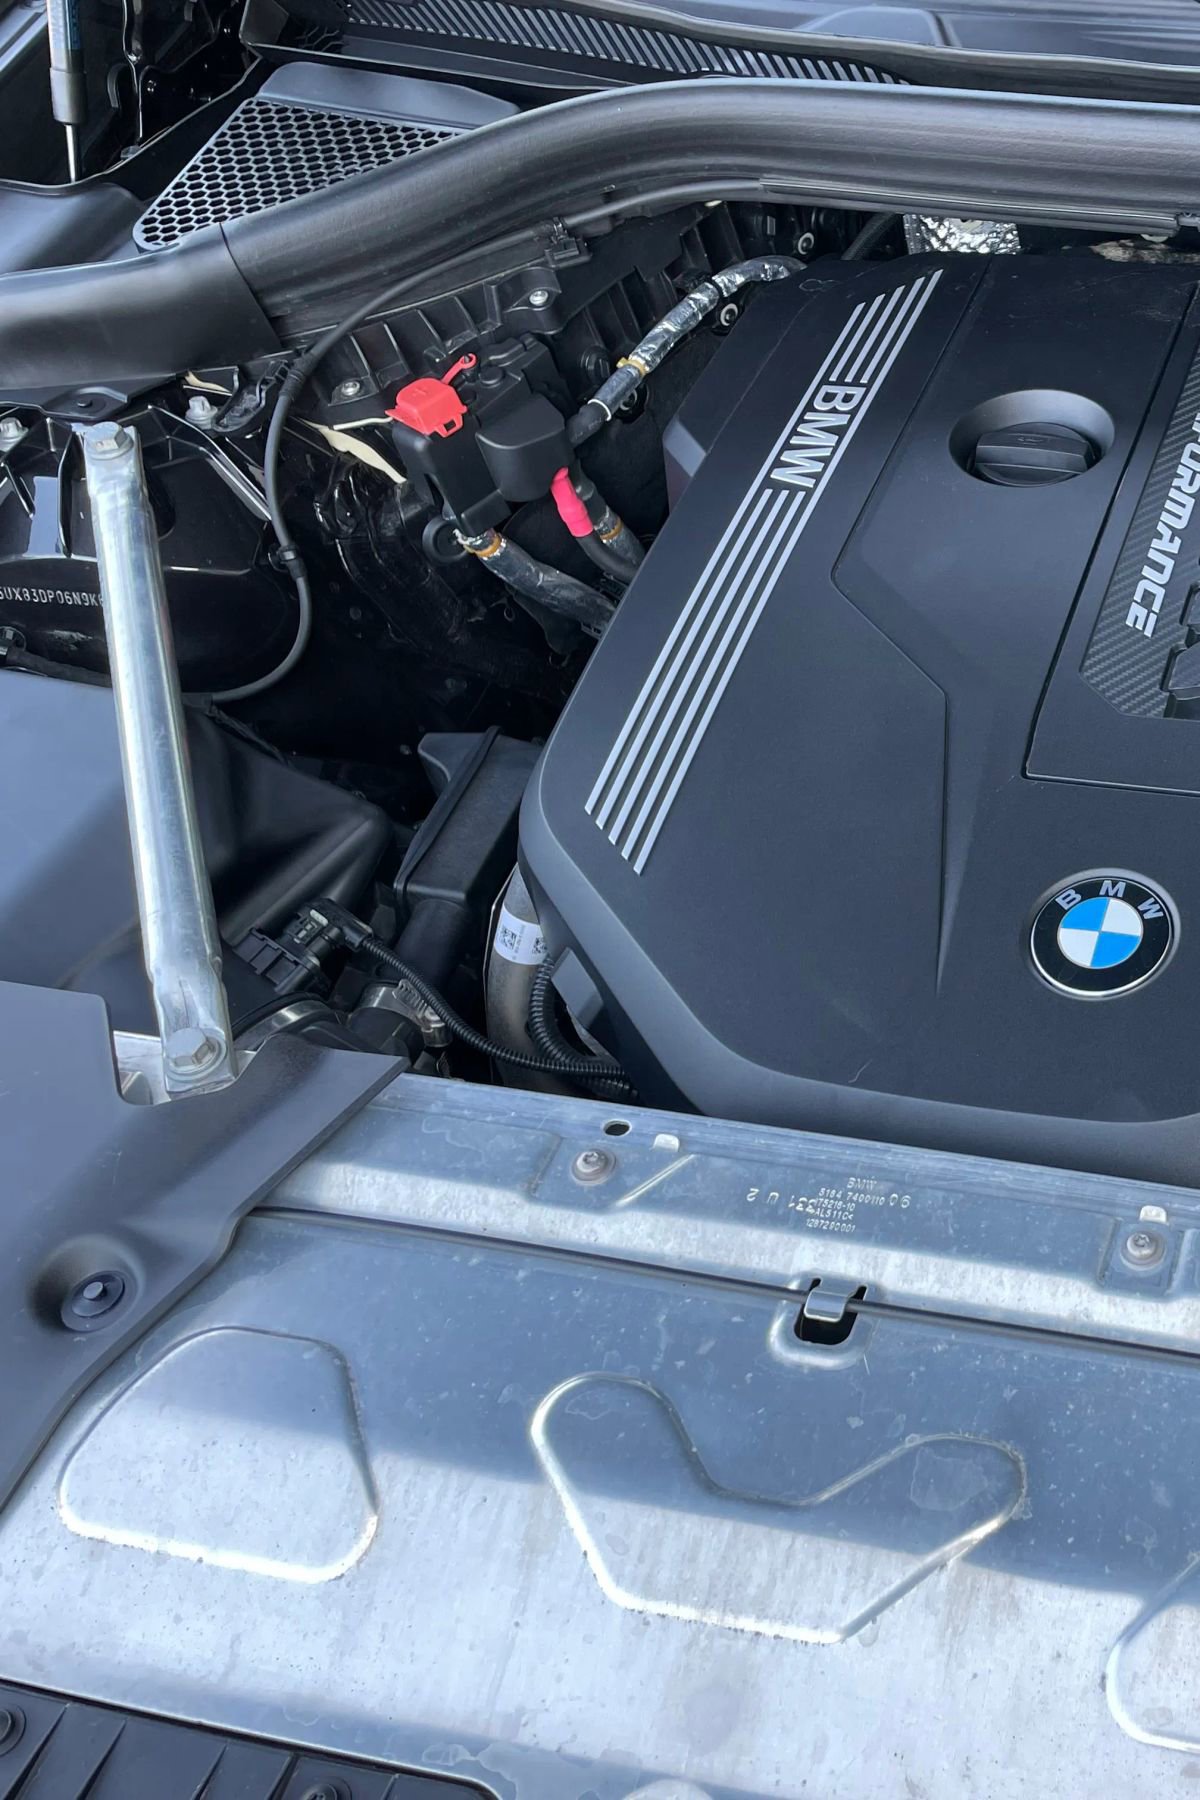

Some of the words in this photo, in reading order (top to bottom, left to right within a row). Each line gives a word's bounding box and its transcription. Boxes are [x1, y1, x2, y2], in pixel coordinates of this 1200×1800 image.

[769, 383, 867, 489] BMW
[1054, 879, 1165, 920] BMW
[846, 1177, 877, 1192] BMW
